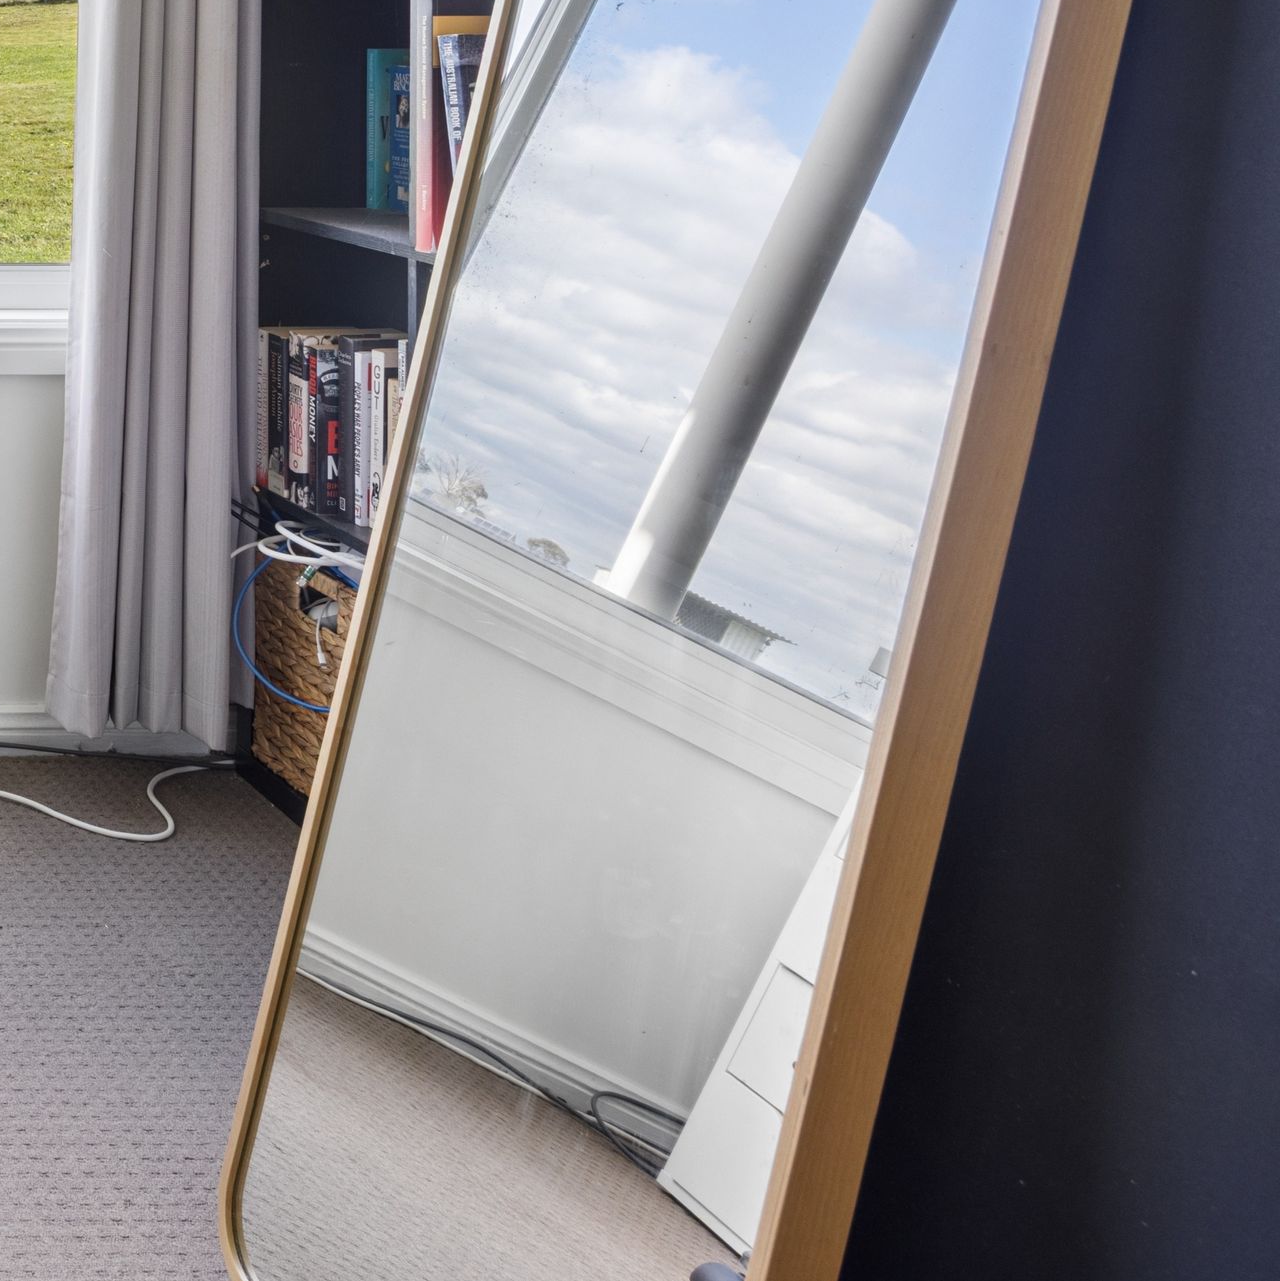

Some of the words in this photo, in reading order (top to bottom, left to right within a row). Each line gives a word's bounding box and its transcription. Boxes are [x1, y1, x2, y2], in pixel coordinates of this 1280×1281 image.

[443, 41, 453, 57] THE
[445, 58, 458, 105] AUSTRALIAN
[451, 106, 461, 128] BOOK
[453, 130, 462, 141] OF
[309, 355, 317, 396] BLOOD
[255, 411, 263, 468] DELUSION
